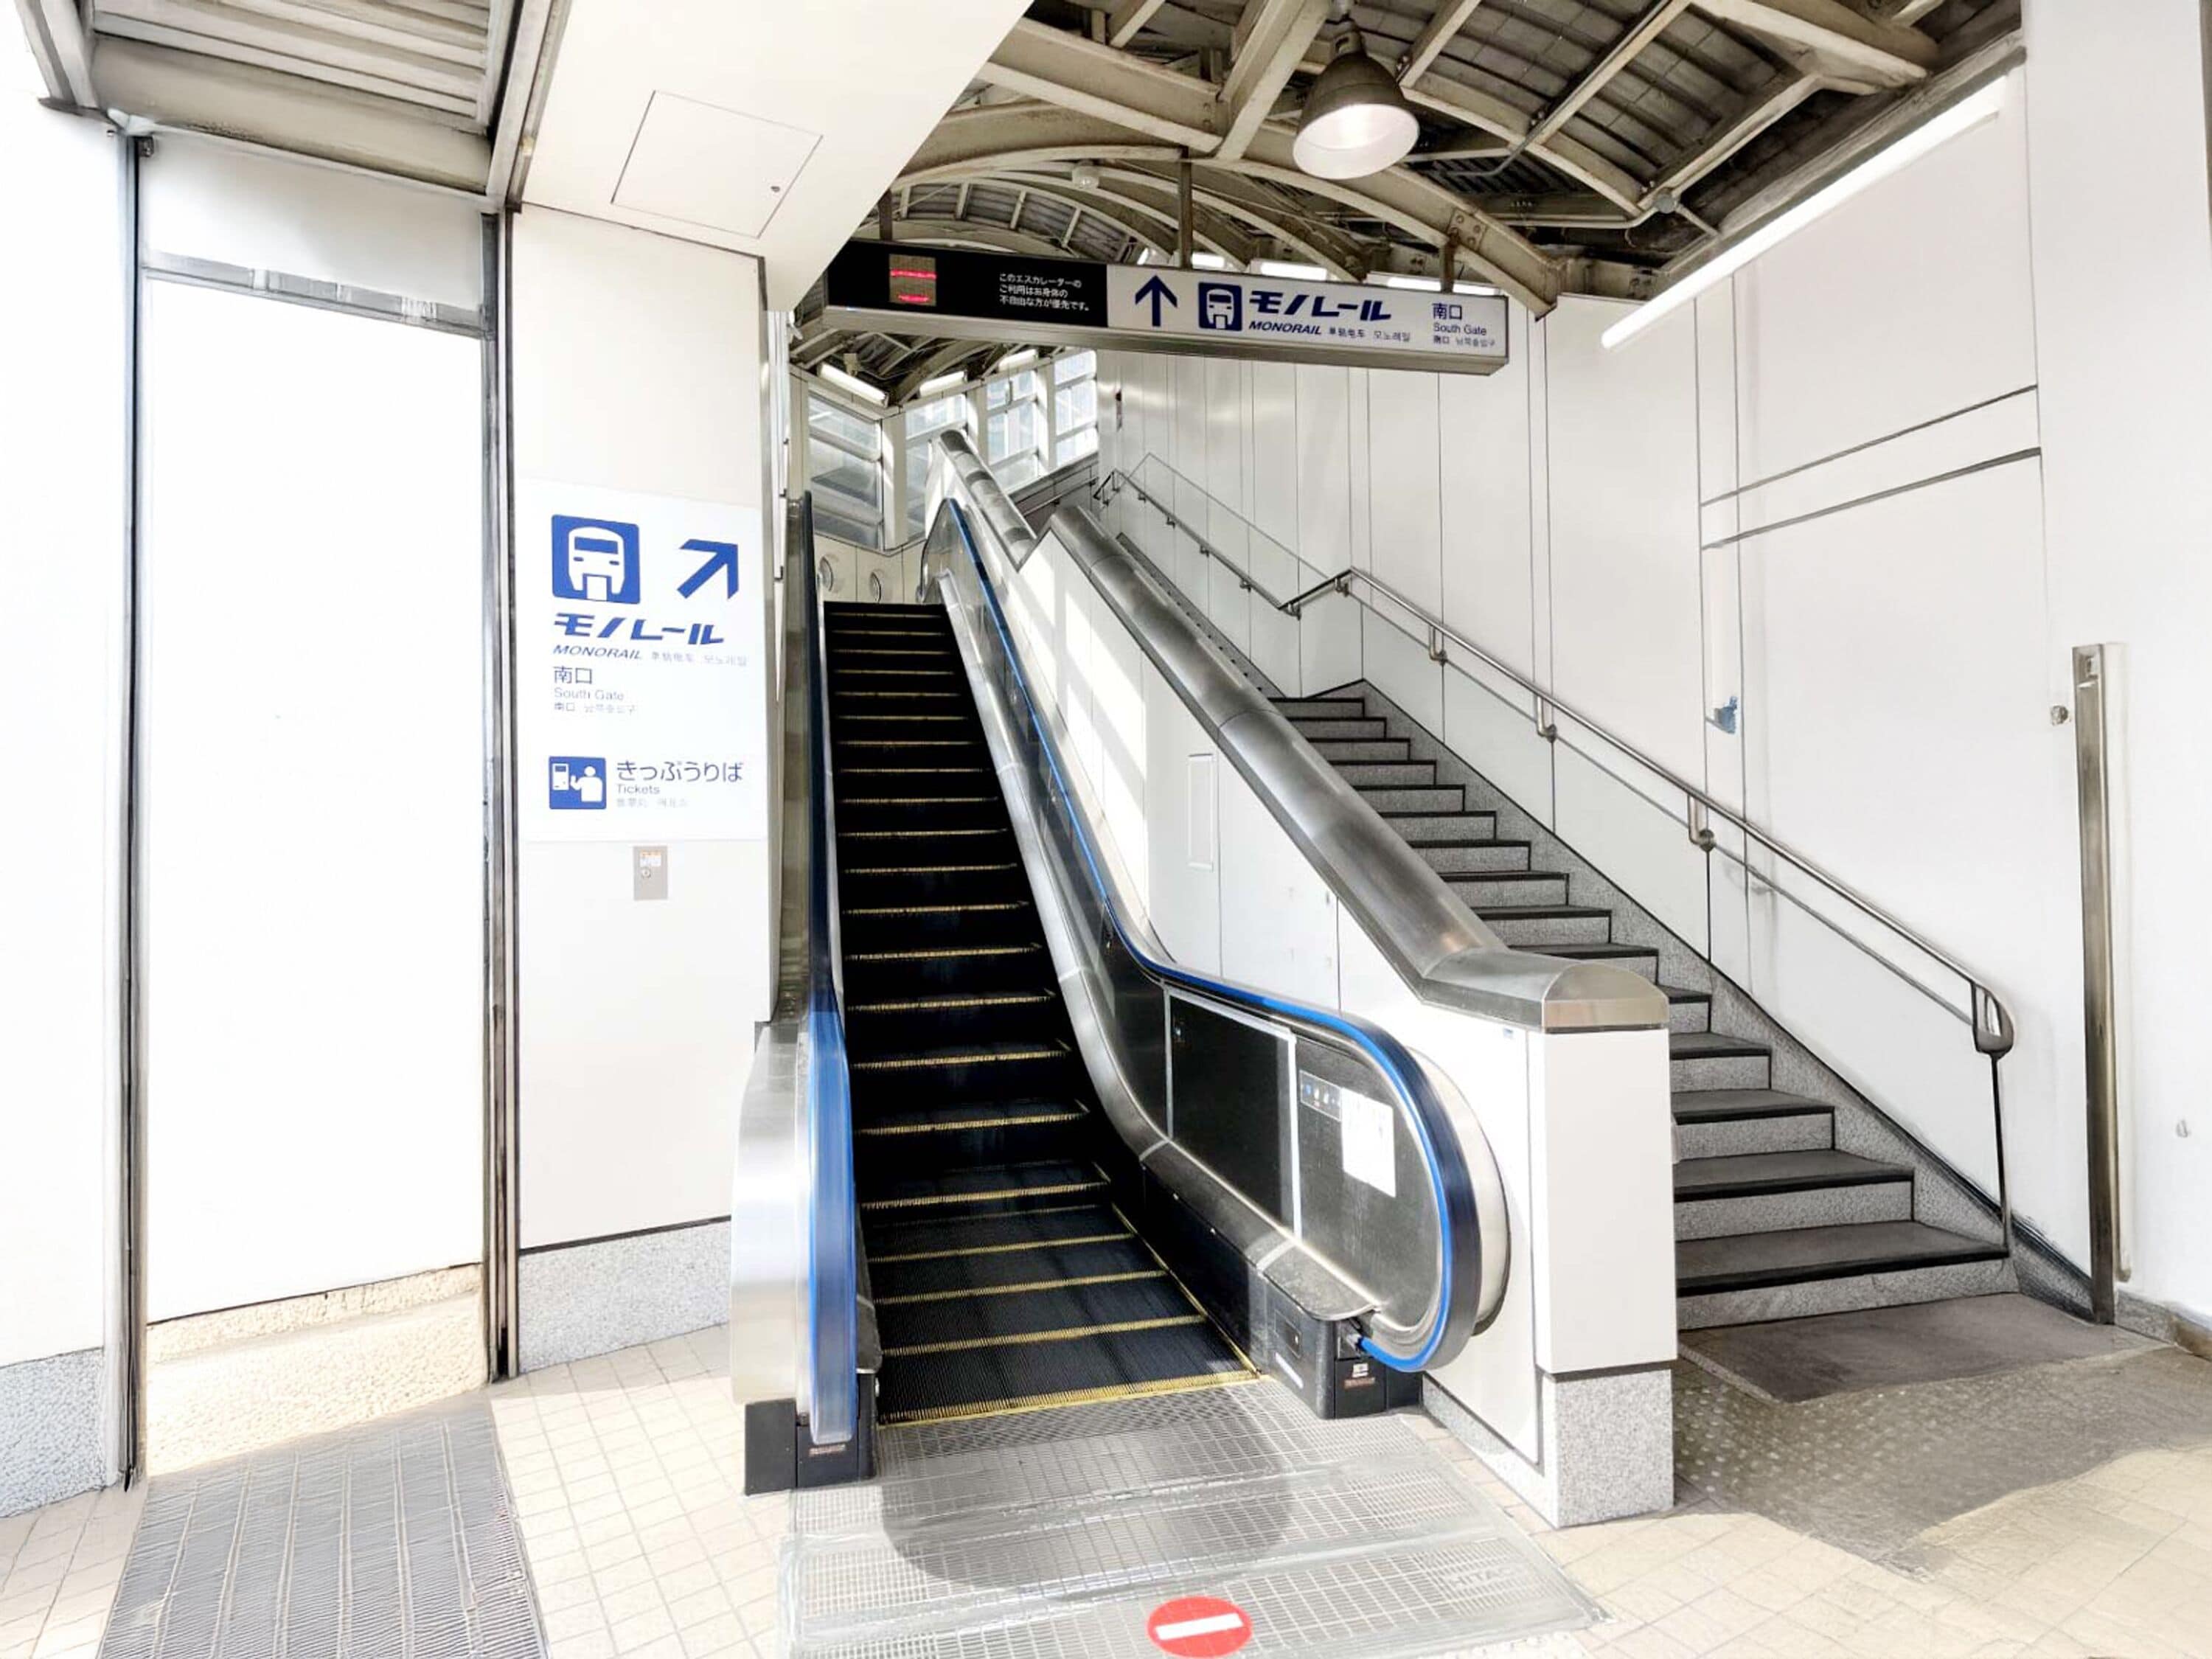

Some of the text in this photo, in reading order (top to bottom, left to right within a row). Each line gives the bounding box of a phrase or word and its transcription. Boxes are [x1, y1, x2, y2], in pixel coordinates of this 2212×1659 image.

[999, 274, 1082, 288] このエスカレーターの
[1249, 291, 1391, 321] モノレール
[1432, 302, 1462, 320] 南口
[1249, 321, 1322, 335] MONORAIL
[1433, 322, 1487, 335] South Gate
[554, 613, 724, 645] モノレール
[553, 644, 642, 660] MONORAIL
[553, 665, 593, 684] 南口
[554, 687, 625, 701] South Gate
[616, 760, 744, 783] きっぷうりば
[616, 784, 661, 795] Tickets
